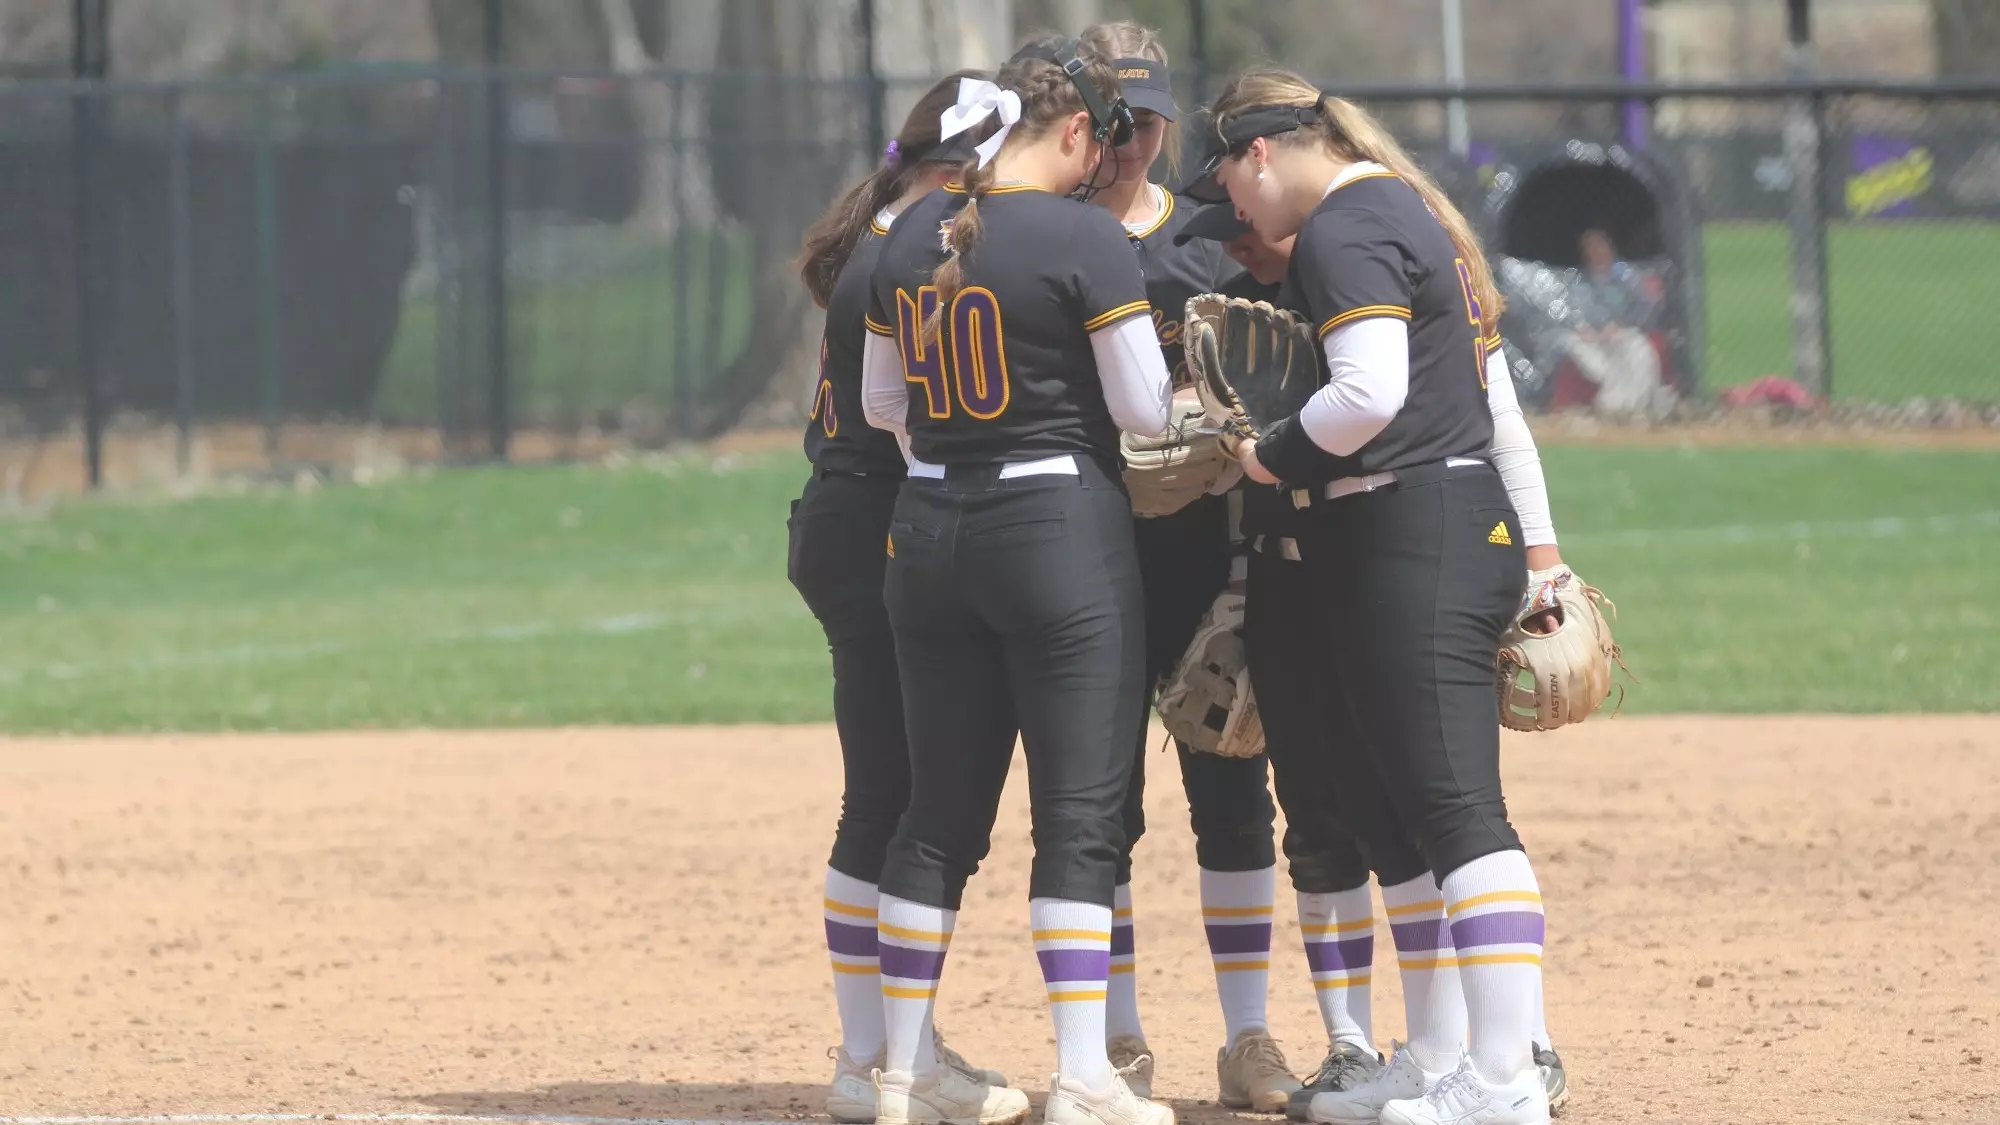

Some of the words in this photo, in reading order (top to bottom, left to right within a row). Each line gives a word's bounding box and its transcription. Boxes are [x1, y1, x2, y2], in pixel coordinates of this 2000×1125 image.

[896, 285, 1010, 420] 40
[1488, 535, 1512, 545] adidas
[1550, 673, 1560, 719] EASTON
